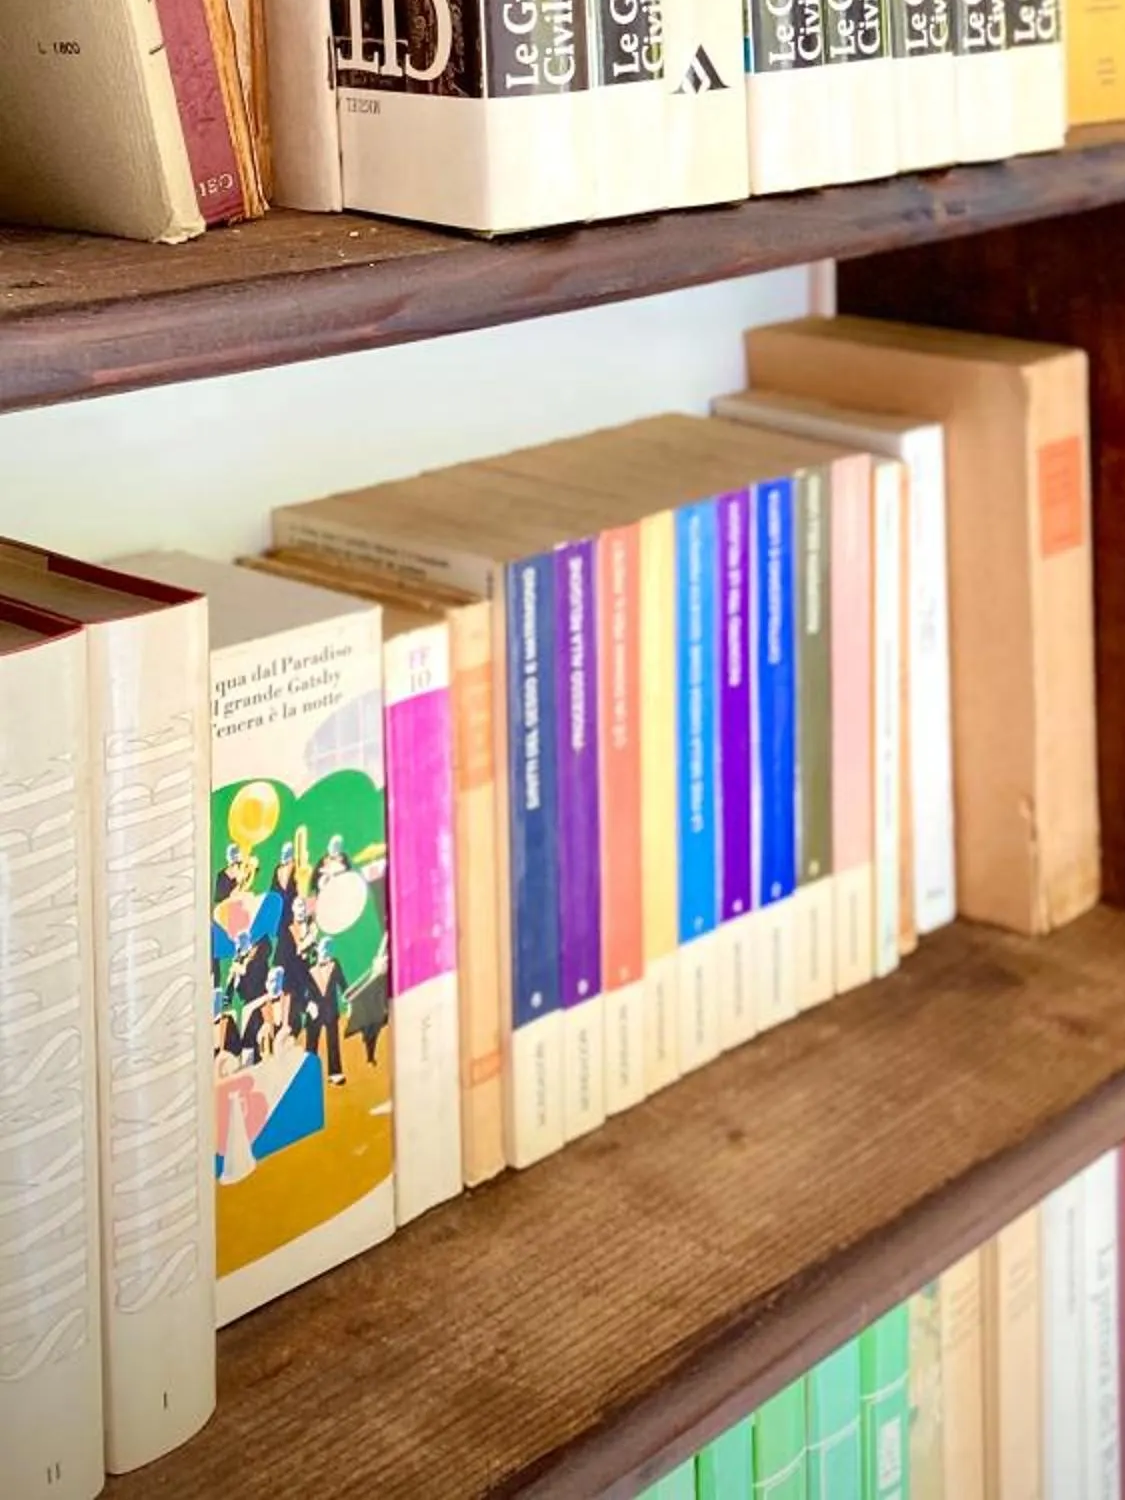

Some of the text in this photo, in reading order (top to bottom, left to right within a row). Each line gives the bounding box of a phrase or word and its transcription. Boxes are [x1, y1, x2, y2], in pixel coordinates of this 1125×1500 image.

[768, 23, 796, 65] Le
[830, 18, 856, 58] Le
[905, 12, 928, 50] Le
[963, 11, 986, 48] Le
[1014, 5, 1035, 42] Le
[506, 43, 539, 89] Le
[613, 33, 640, 77] Le
[215, 644, 352, 698] qua dal Paradiso
[223, 684, 283, 718] grande
[287, 667, 342, 695] Gatsby
[283, 702, 297, 720] la
[303, 691, 344, 714] notte
